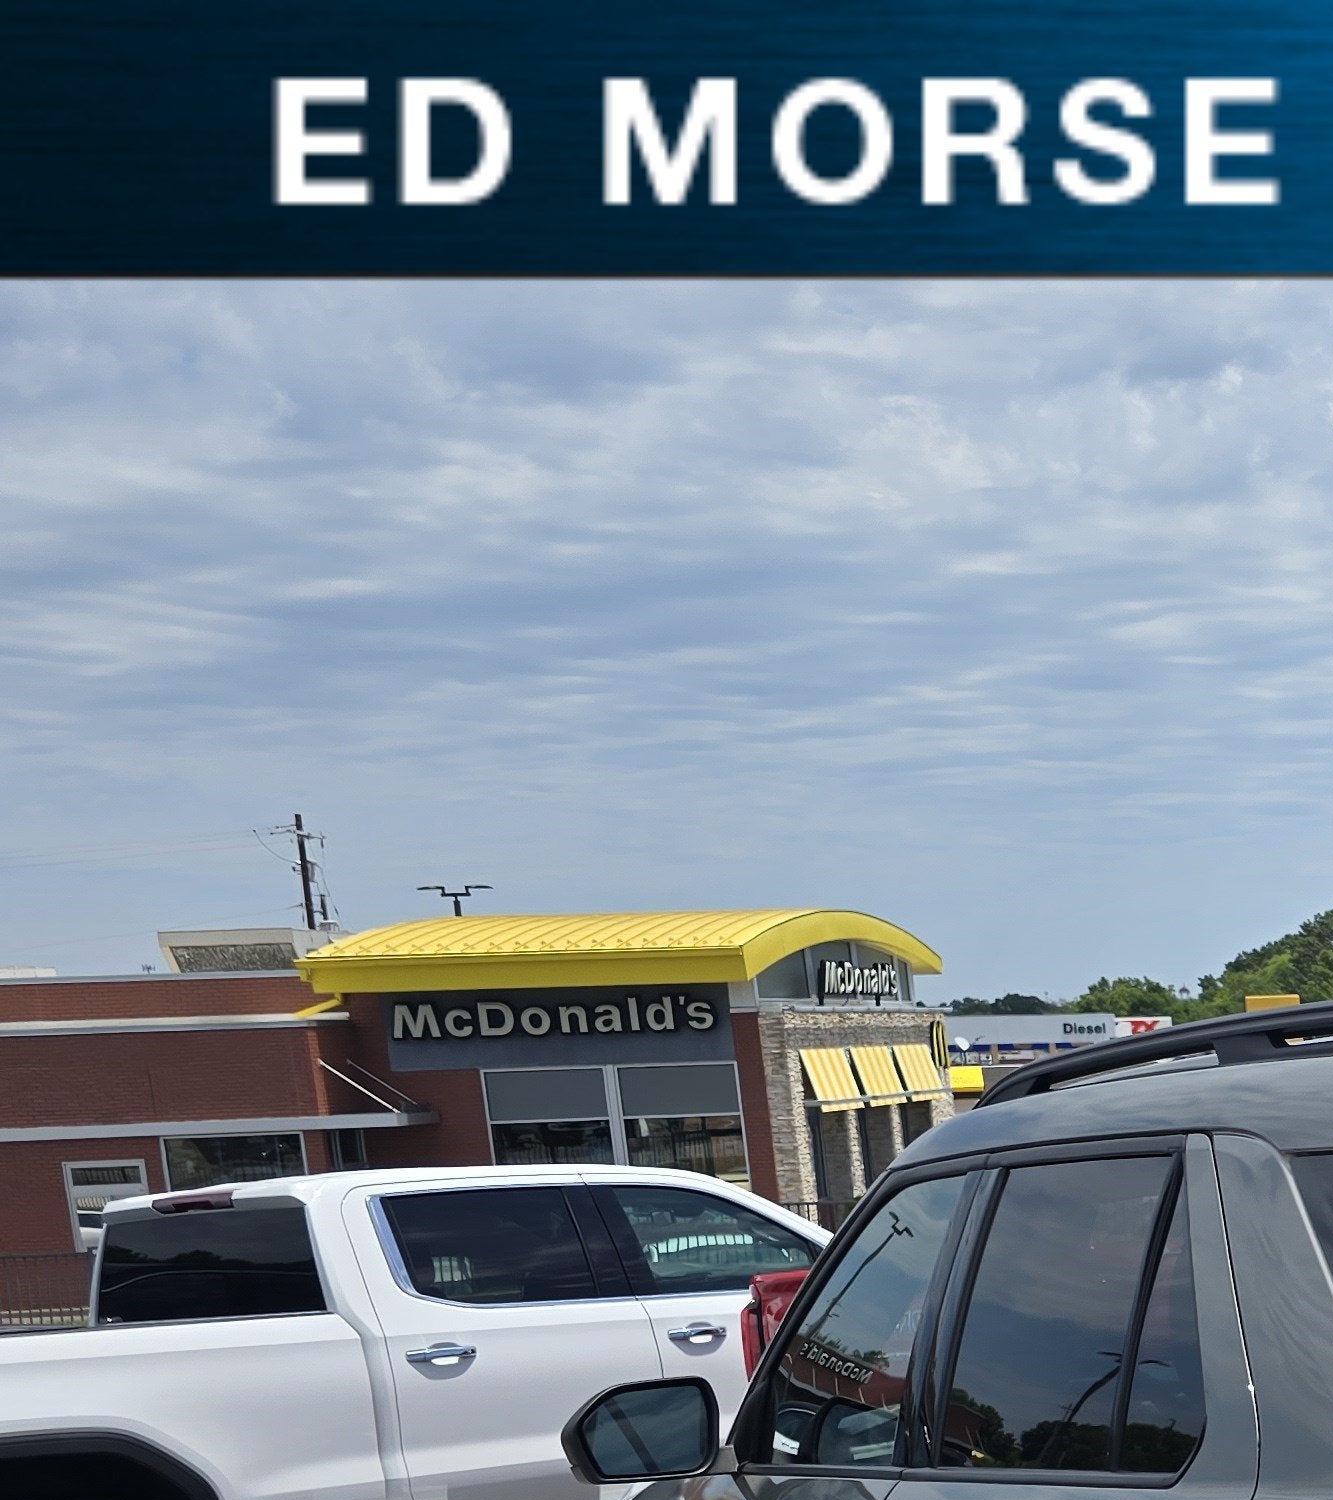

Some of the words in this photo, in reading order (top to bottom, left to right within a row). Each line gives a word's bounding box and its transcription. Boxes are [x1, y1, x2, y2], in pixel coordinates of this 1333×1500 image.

[824, 960, 898, 994] McDonald's
[392, 995, 715, 1039] McDonald's
[1062, 1021, 1107, 1036] Diesel
